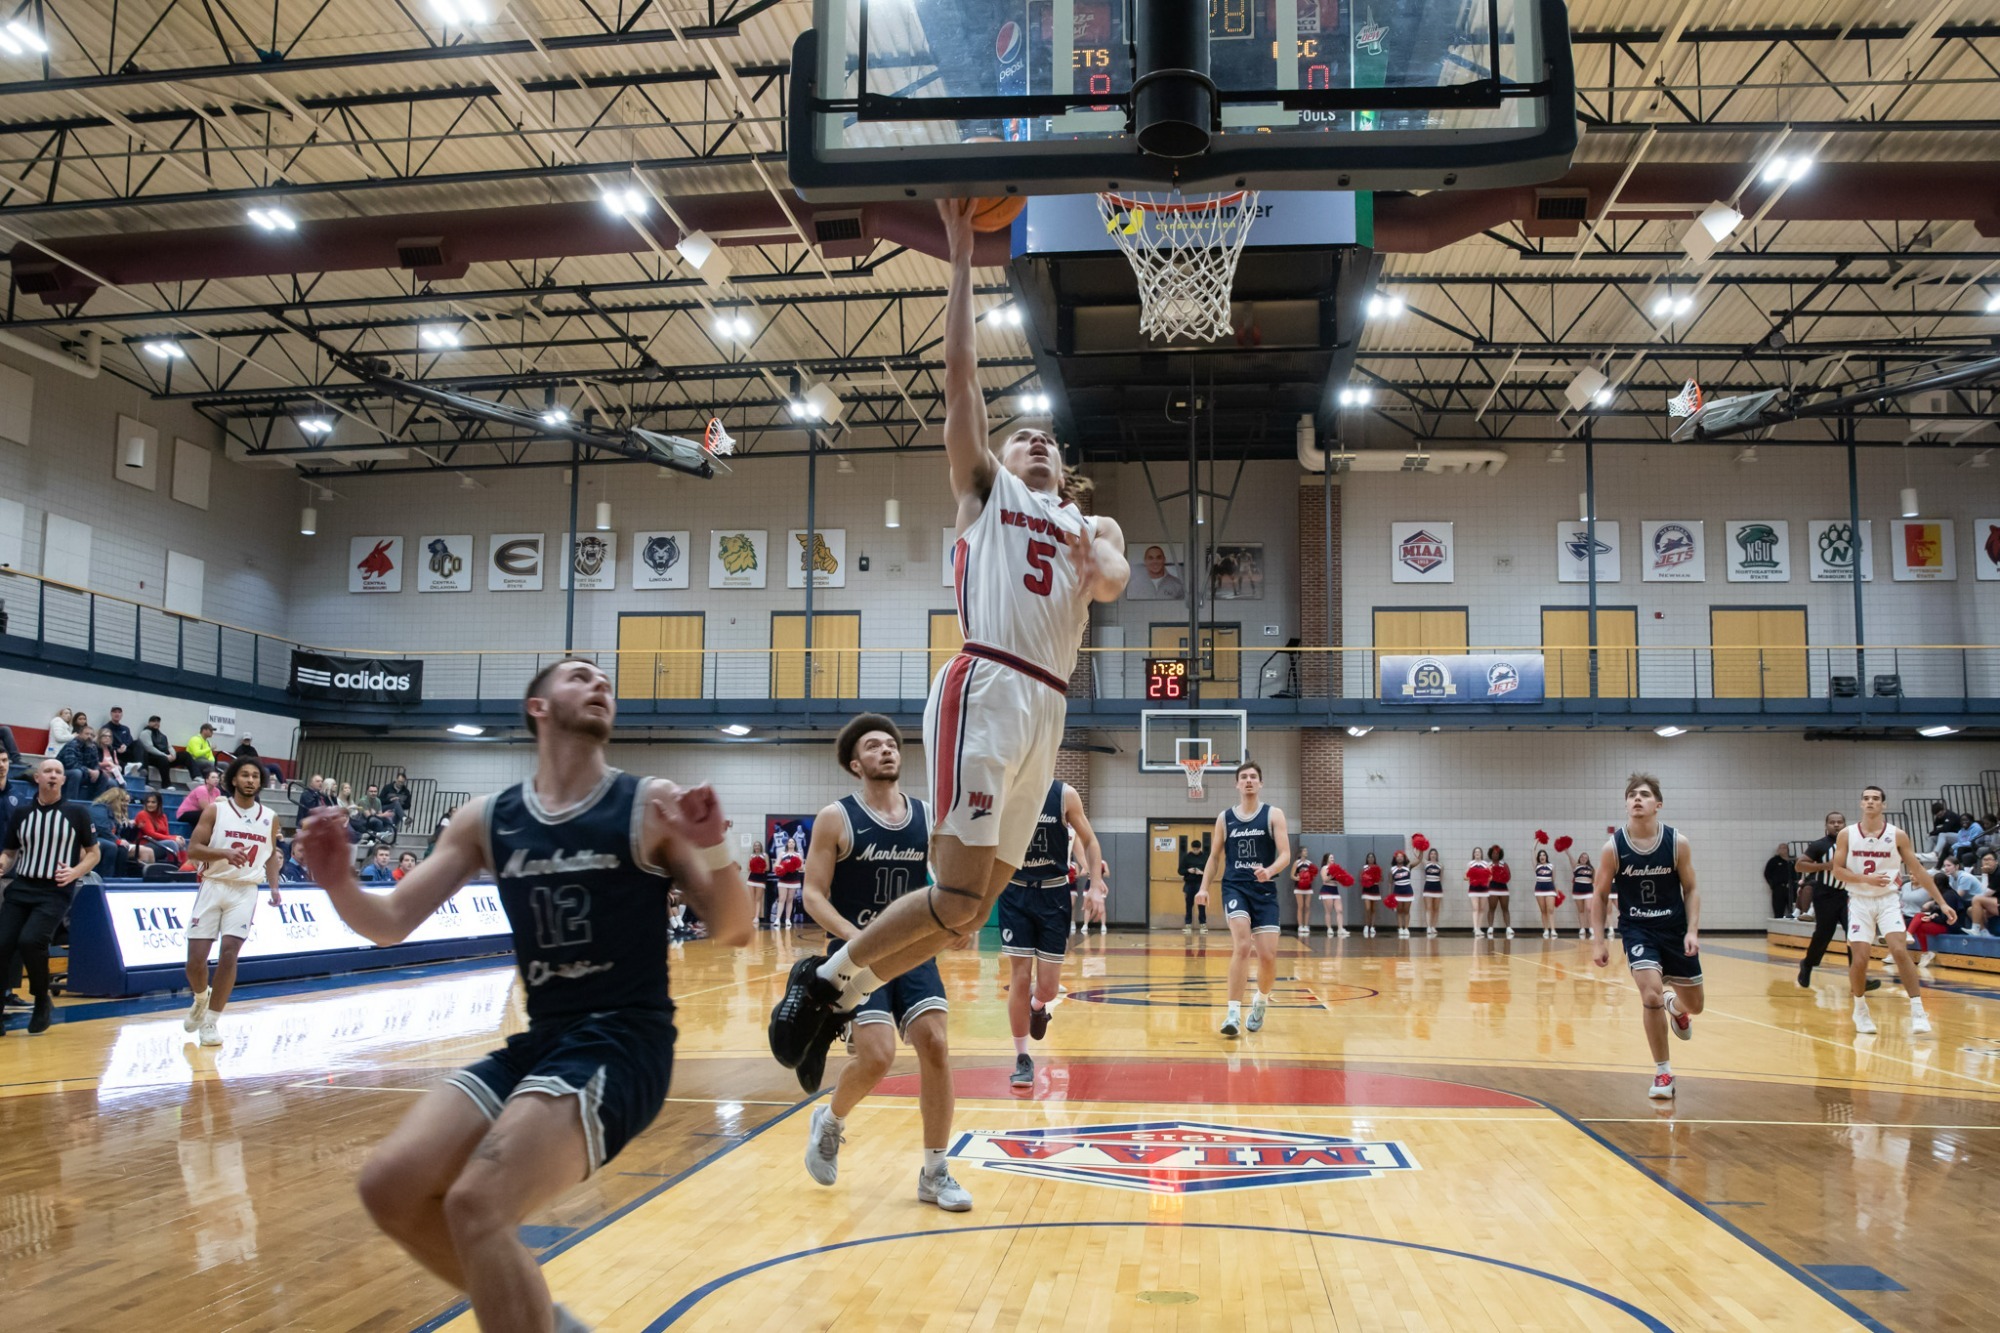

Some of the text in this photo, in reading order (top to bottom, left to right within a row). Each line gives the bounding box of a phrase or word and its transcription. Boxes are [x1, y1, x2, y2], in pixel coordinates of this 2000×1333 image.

[999, 62, 1024, 82] pepsi
[1000, 508, 1071, 546] NEWM
[1402, 544, 1444, 558] MIAA
[1746, 540, 1771, 562] NSU
[432, 553, 462, 579] UCO
[1023, 538, 1056, 597] 5
[1153, 663, 1184, 675] 17:28
[334, 670, 410, 691] adidas
[1150, 676, 1179, 697] 26
[1418, 671, 1441, 688] 50
[209, 714, 235, 725] NEWMAN
[968, 791, 993, 810] NU
[224, 829, 267, 843] NEWMAN
[1230, 828, 1266, 838] Manhattan
[855, 843, 925, 862] Manhattan
[1238, 838, 1256, 858] 21
[1852, 850, 1891, 858] NEWMAN
[1022, 858, 1056, 868] hristian
[1621, 865, 1672, 877] Manhattan
[1863, 860, 1876, 875] 2
[874, 867, 910, 904] 10
[1640, 879, 1656, 904] 2
[279, 903, 316, 923] ECK
[472, 896, 498, 913] ECK
[1629, 906, 1673, 917] Christian
[133, 907, 184, 931] ECK
[530, 884, 592, 948] 12
[1131, 1133, 1226, 1142] 1912
[987, 1138, 1376, 1165] MIAA
